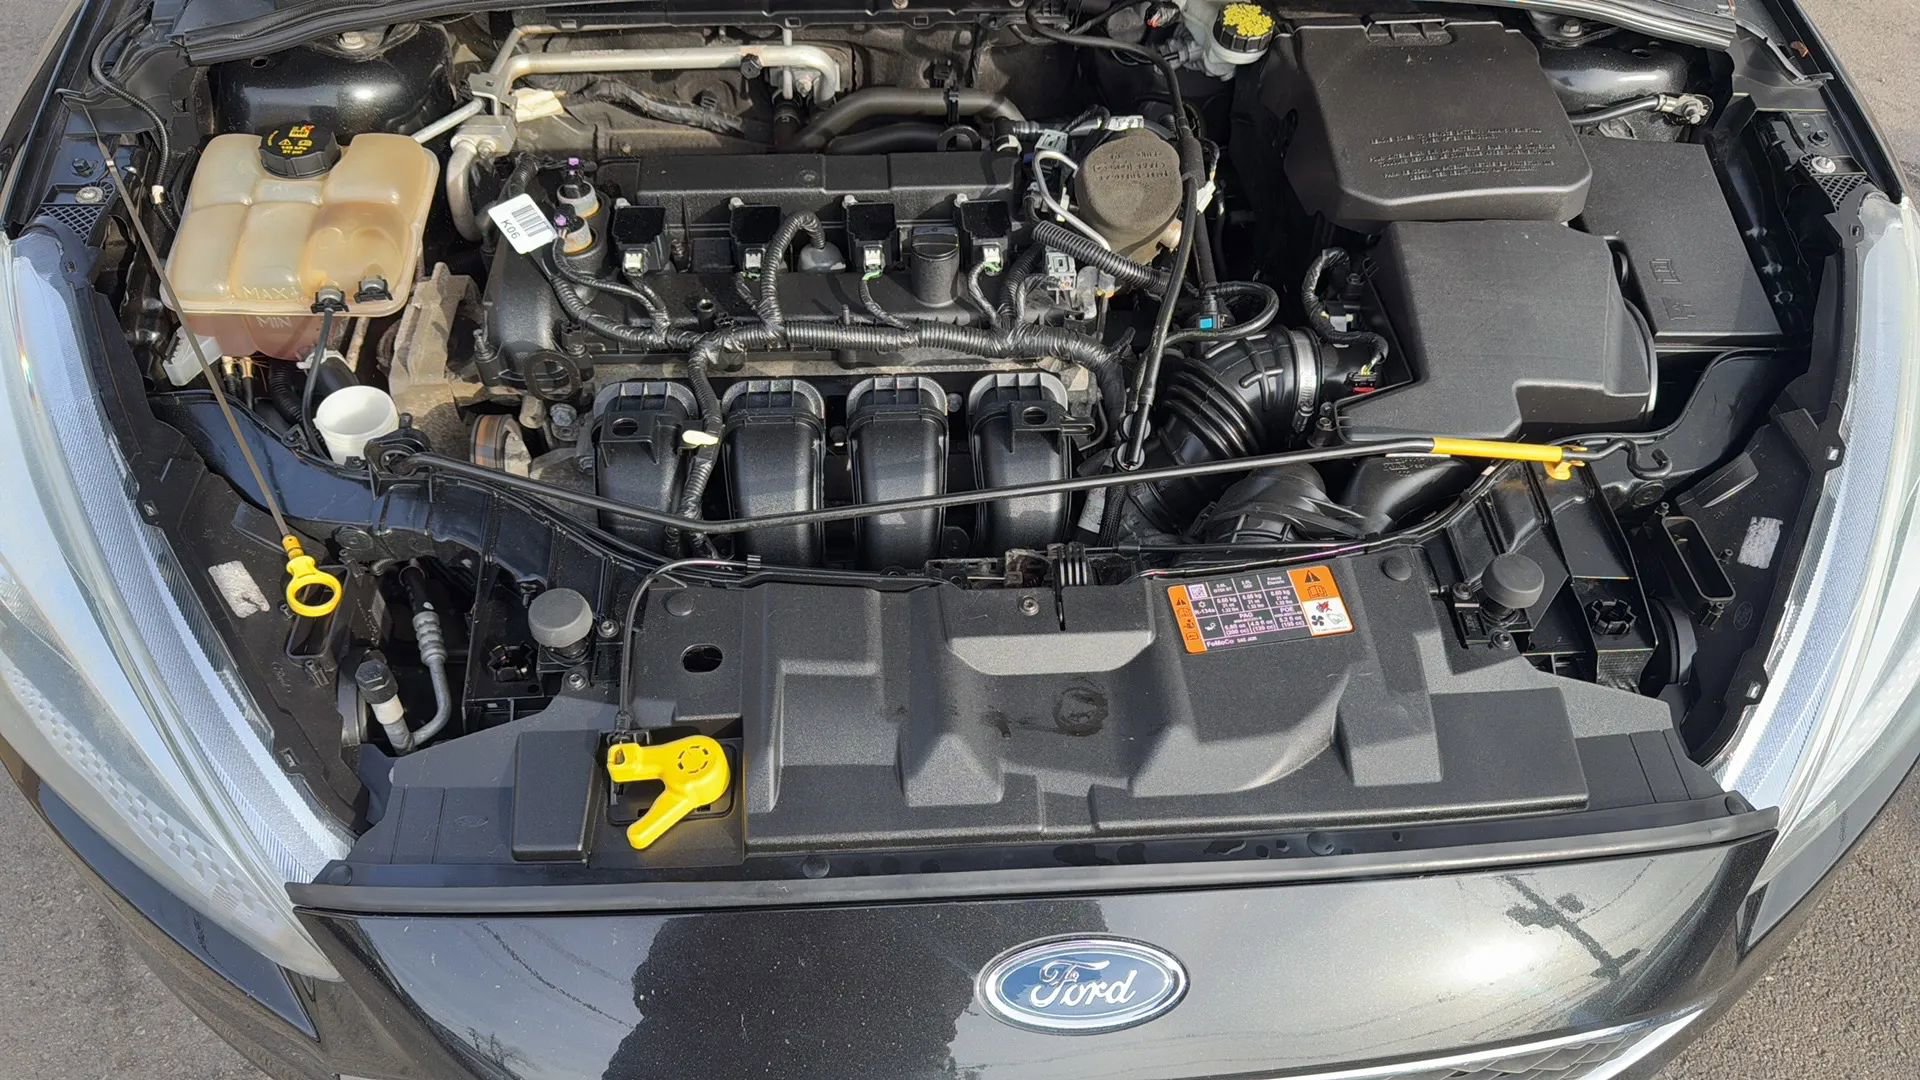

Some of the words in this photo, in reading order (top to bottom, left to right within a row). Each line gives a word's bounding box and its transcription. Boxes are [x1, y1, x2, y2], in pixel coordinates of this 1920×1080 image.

[501, 219, 520, 240] K06
[242, 286, 289, 300] MAX
[256, 316, 291, 328] MIN
[1206, 638, 1234, 647] FoMoCo
[1030, 960, 1138, 1008] Ford
